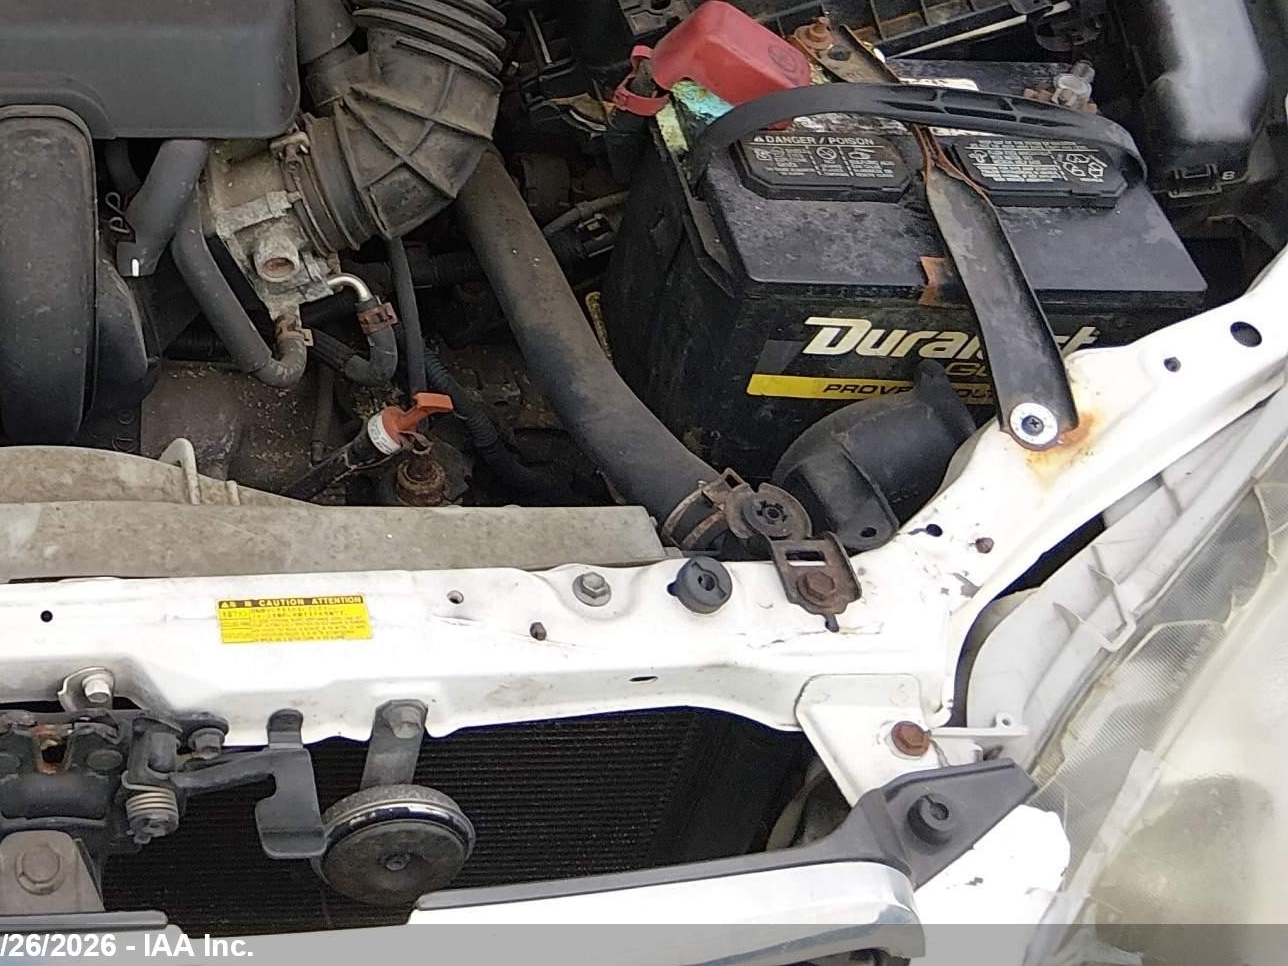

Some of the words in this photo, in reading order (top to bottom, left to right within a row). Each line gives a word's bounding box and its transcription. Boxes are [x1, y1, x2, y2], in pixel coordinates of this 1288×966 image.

[765, 135, 817, 145] DANGER
[829, 136, 875, 146] POISON
[258, 598, 305, 608] CAUTION
[311, 595, 362, 606] ATTENTION
